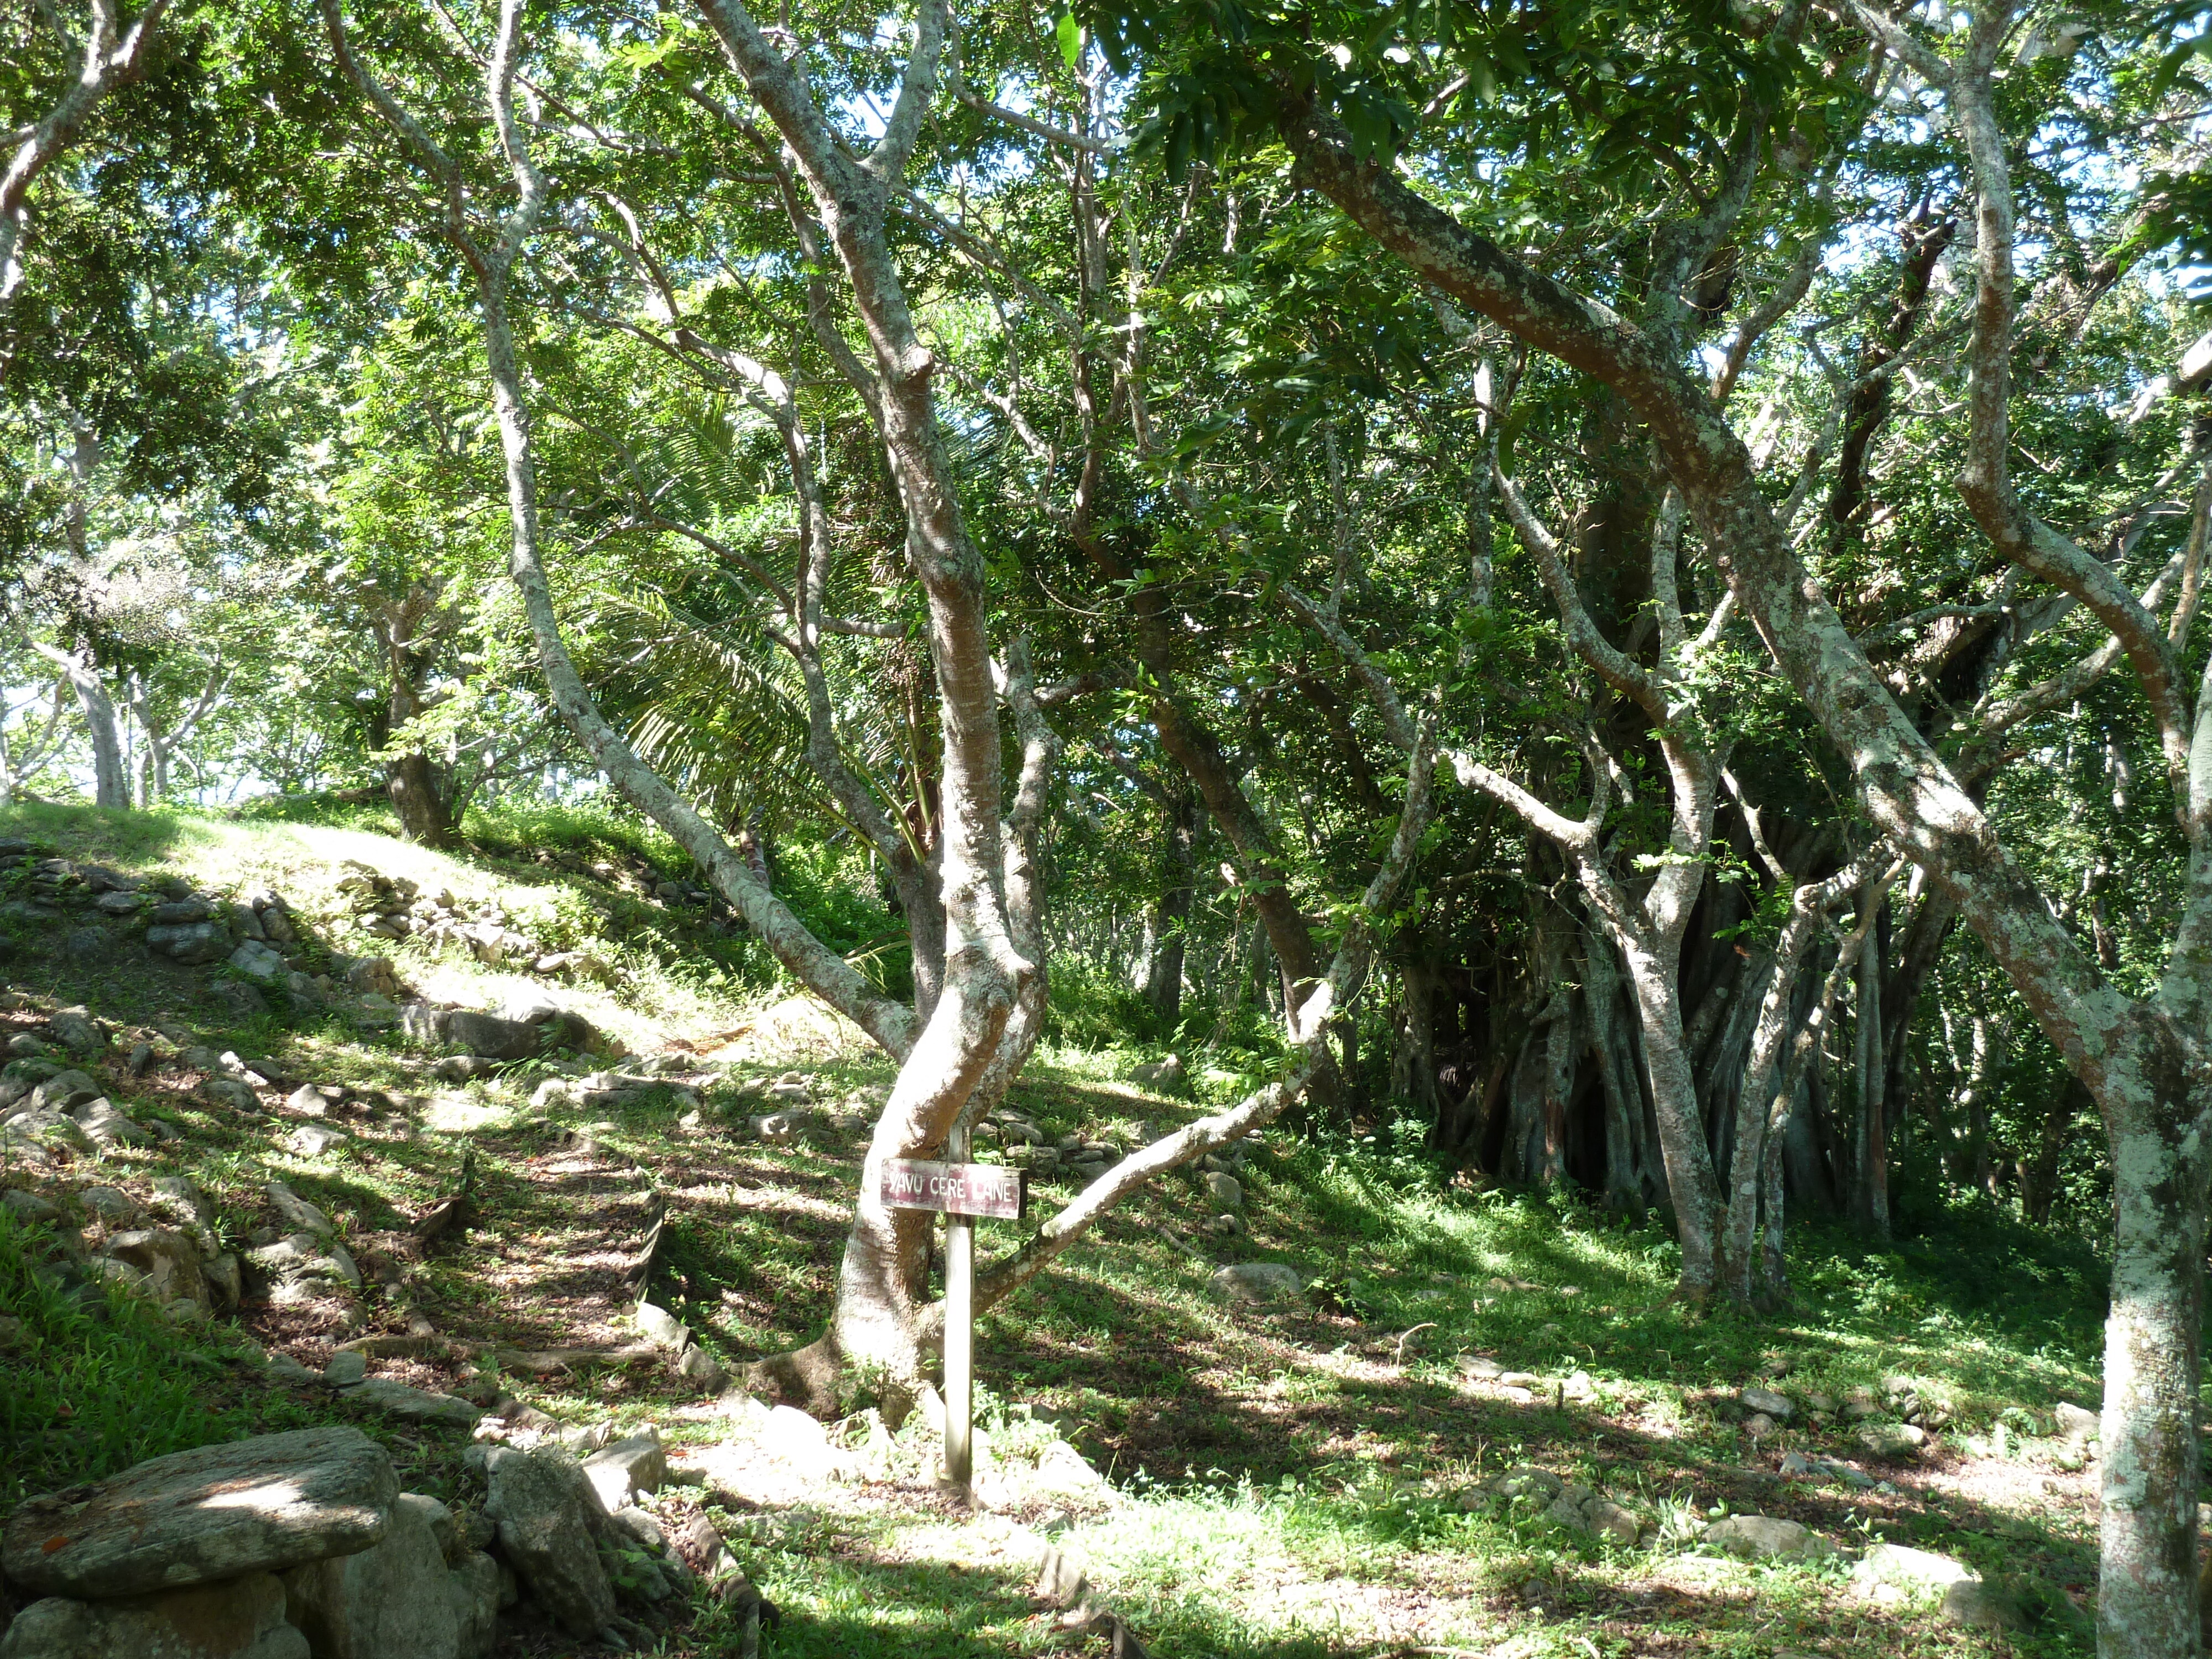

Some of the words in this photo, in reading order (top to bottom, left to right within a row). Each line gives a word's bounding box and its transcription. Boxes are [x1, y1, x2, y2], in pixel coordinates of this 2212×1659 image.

[888, 1173, 922, 1194] YAVU
[930, 1176, 966, 1198] CERE
[972, 1180, 1012, 1202] LANE
